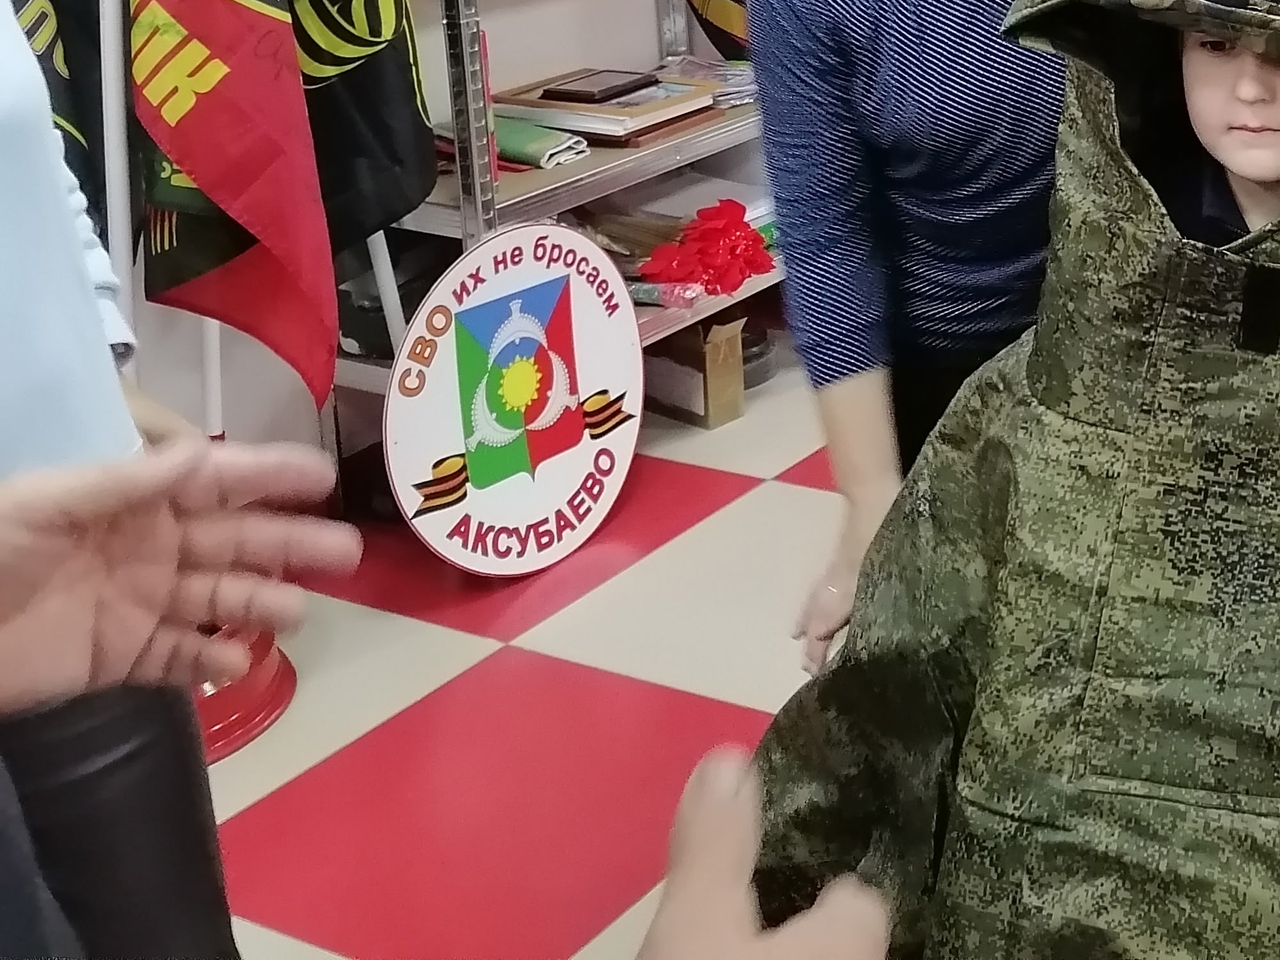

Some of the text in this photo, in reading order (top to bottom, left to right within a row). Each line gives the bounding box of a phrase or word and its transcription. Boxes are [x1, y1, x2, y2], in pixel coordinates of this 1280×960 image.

[398, 235, 621, 398] СВО их не бросаем
[446, 447, 617, 559] АКСУБАЕВО
